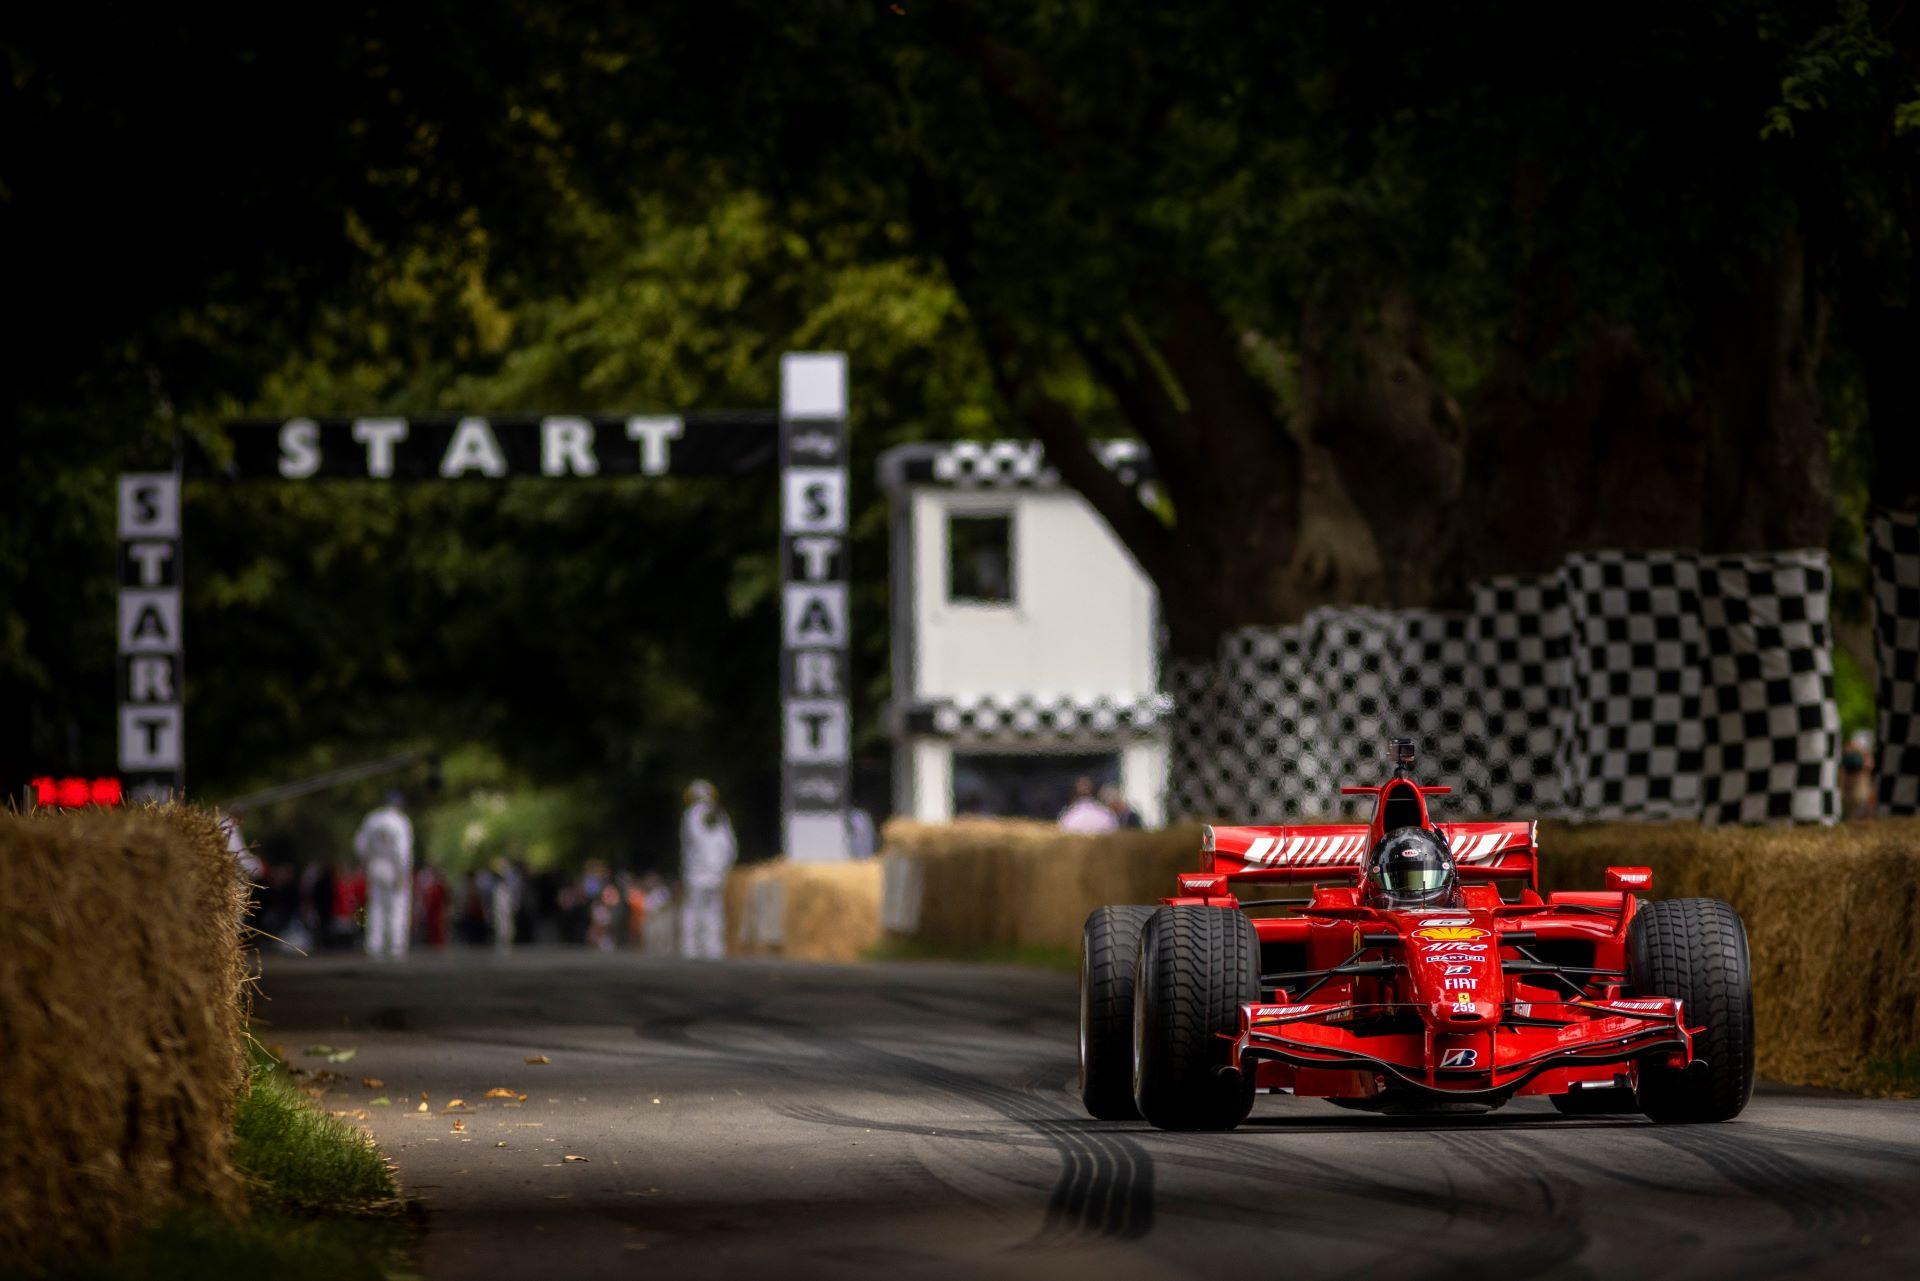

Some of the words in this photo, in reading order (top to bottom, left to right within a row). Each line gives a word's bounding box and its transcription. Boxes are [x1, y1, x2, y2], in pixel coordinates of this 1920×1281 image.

[277, 414, 685, 480] START
[128, 486, 175, 755] START
[792, 484, 839, 750] START
[1445, 978, 1478, 990] FIAT
[1452, 1002, 1476, 1013] 259
